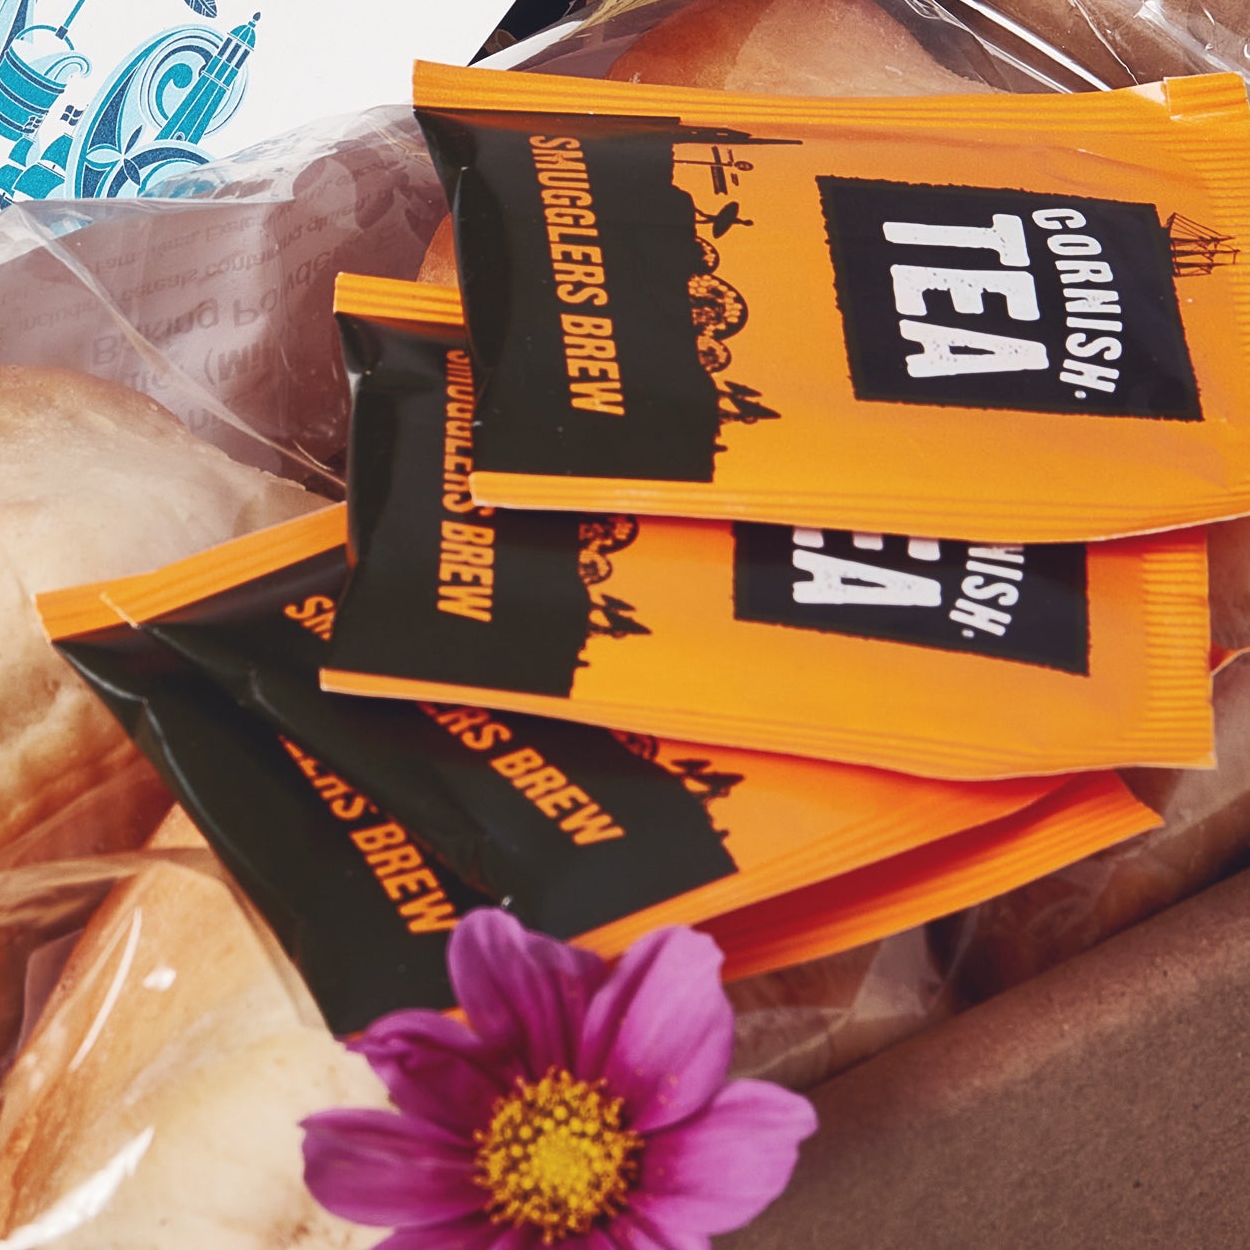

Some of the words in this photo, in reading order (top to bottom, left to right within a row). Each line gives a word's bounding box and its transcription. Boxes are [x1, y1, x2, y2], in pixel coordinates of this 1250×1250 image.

[528, 135, 609, 306] SMUGGLERS
[882, 212, 1050, 379] TEA
[560, 313, 625, 417] BREW
[437, 519, 495, 623] BREW
[489, 746, 626, 846] BREW
[350, 822, 460, 934] BREW
